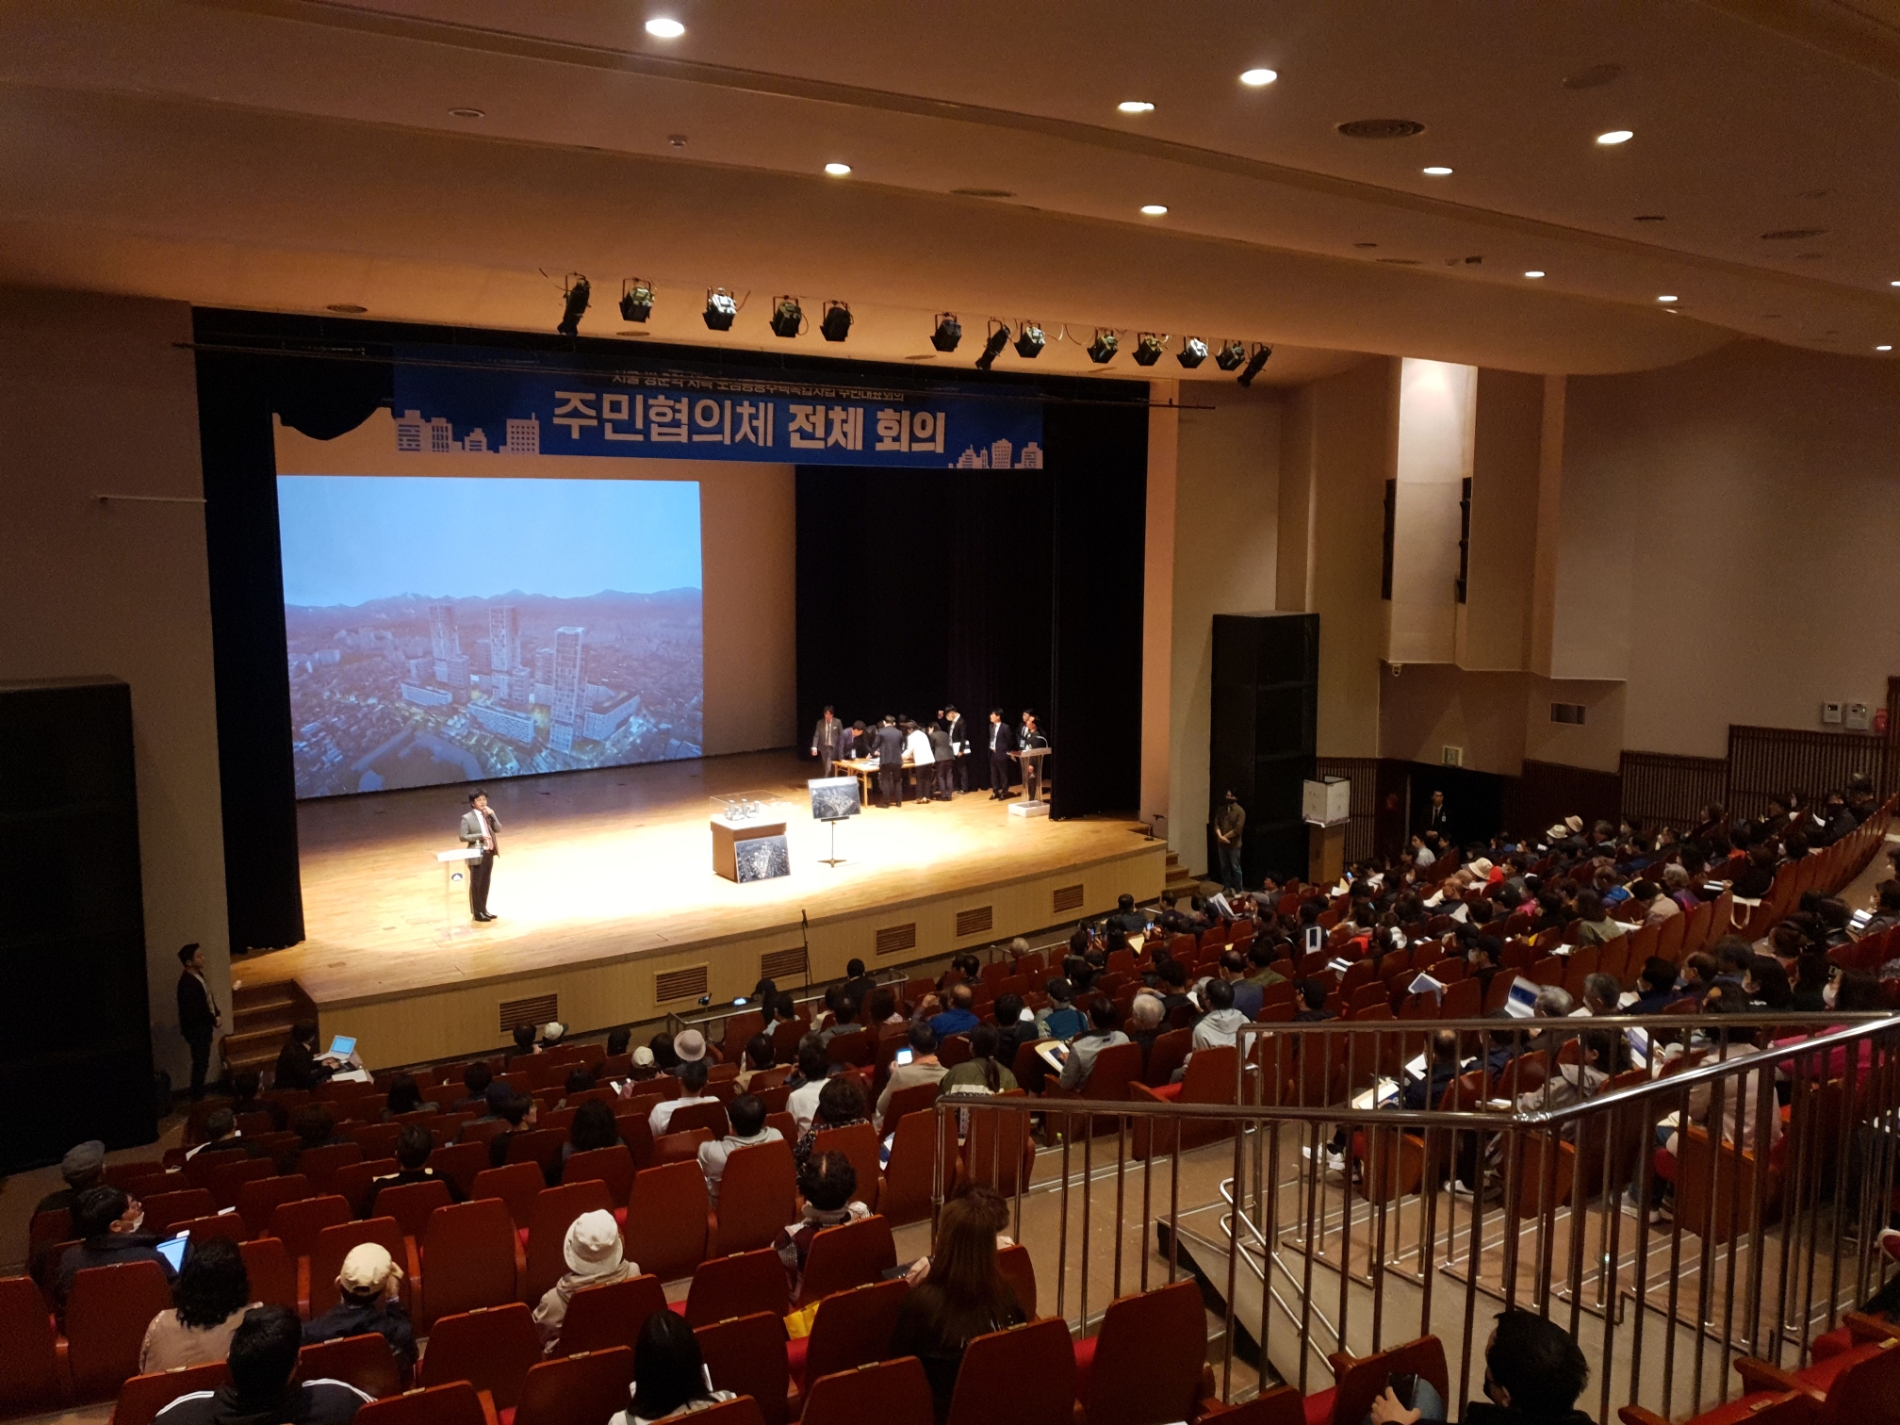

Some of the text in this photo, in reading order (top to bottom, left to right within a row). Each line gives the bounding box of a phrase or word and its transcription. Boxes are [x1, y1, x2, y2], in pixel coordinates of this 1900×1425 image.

[552, 390, 946, 454] 주민협의체 전체 회의
